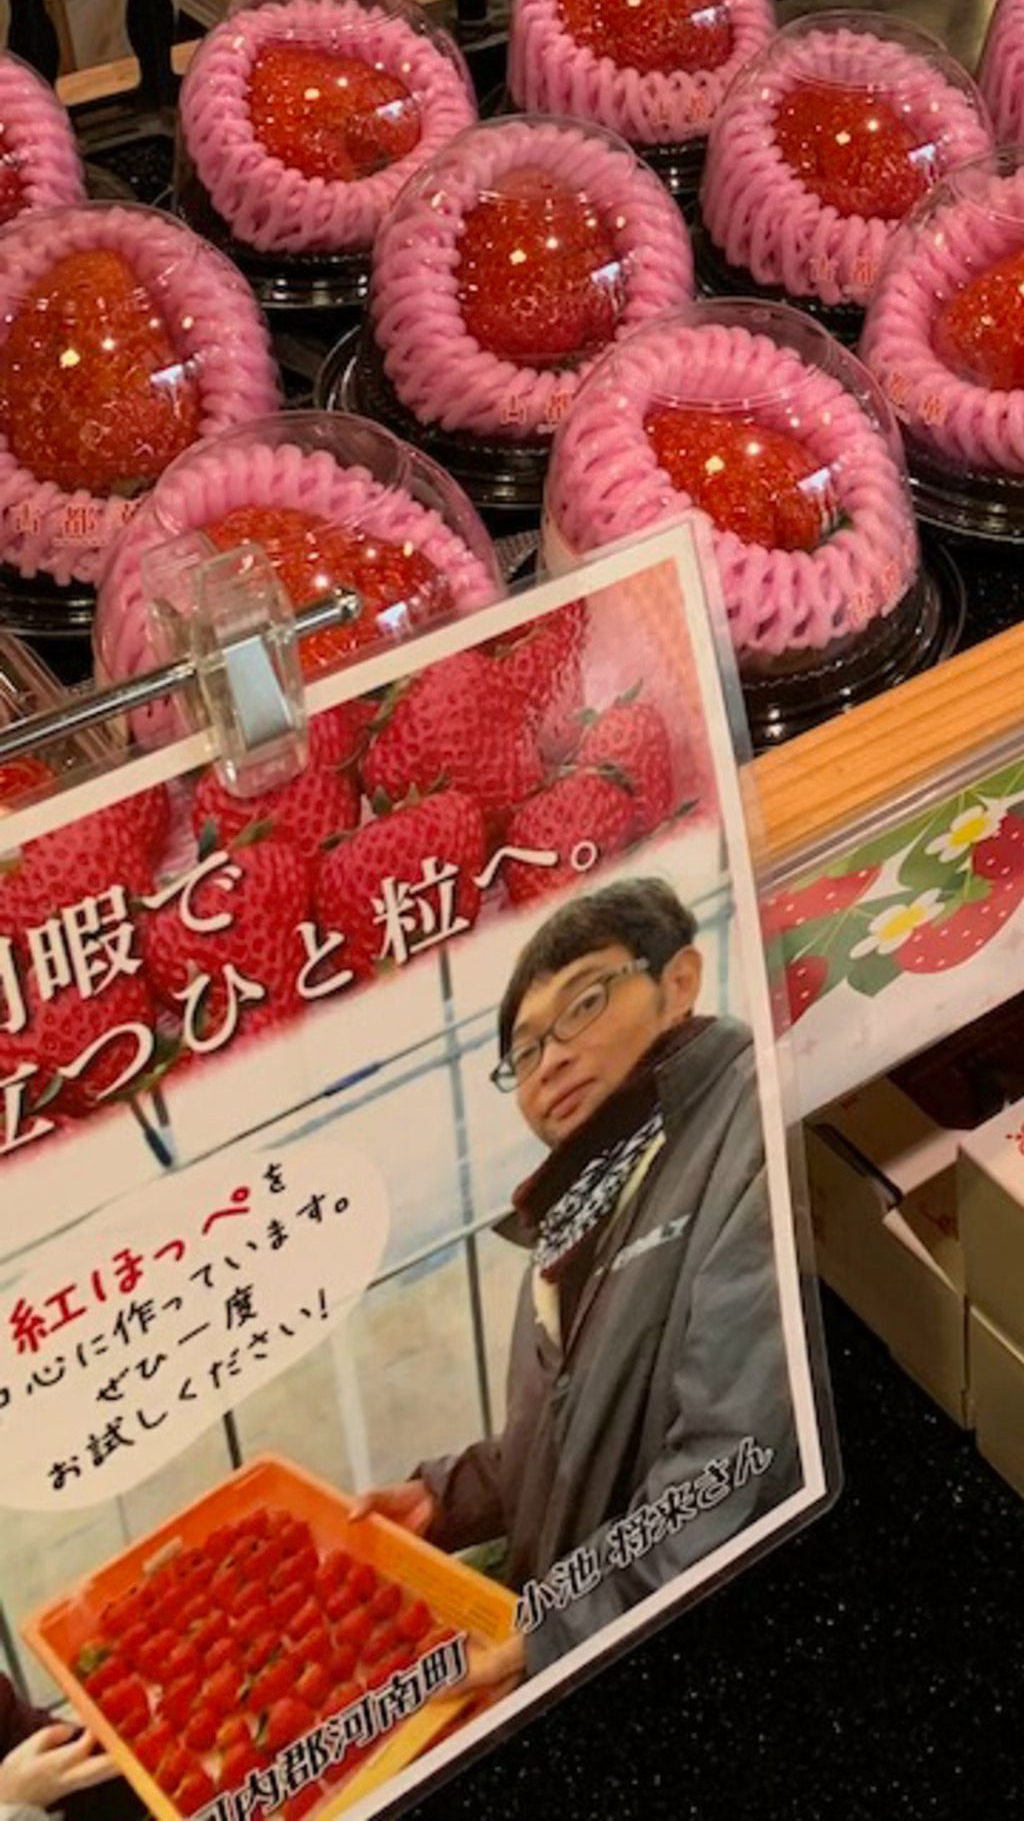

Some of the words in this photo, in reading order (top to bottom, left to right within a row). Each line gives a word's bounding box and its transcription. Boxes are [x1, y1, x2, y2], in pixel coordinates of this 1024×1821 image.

[96, 1283, 258, 1403] ぜひ一度
[513, 1545, 601, 1634] 小池
[606, 1436, 774, 1571] 将来さん
